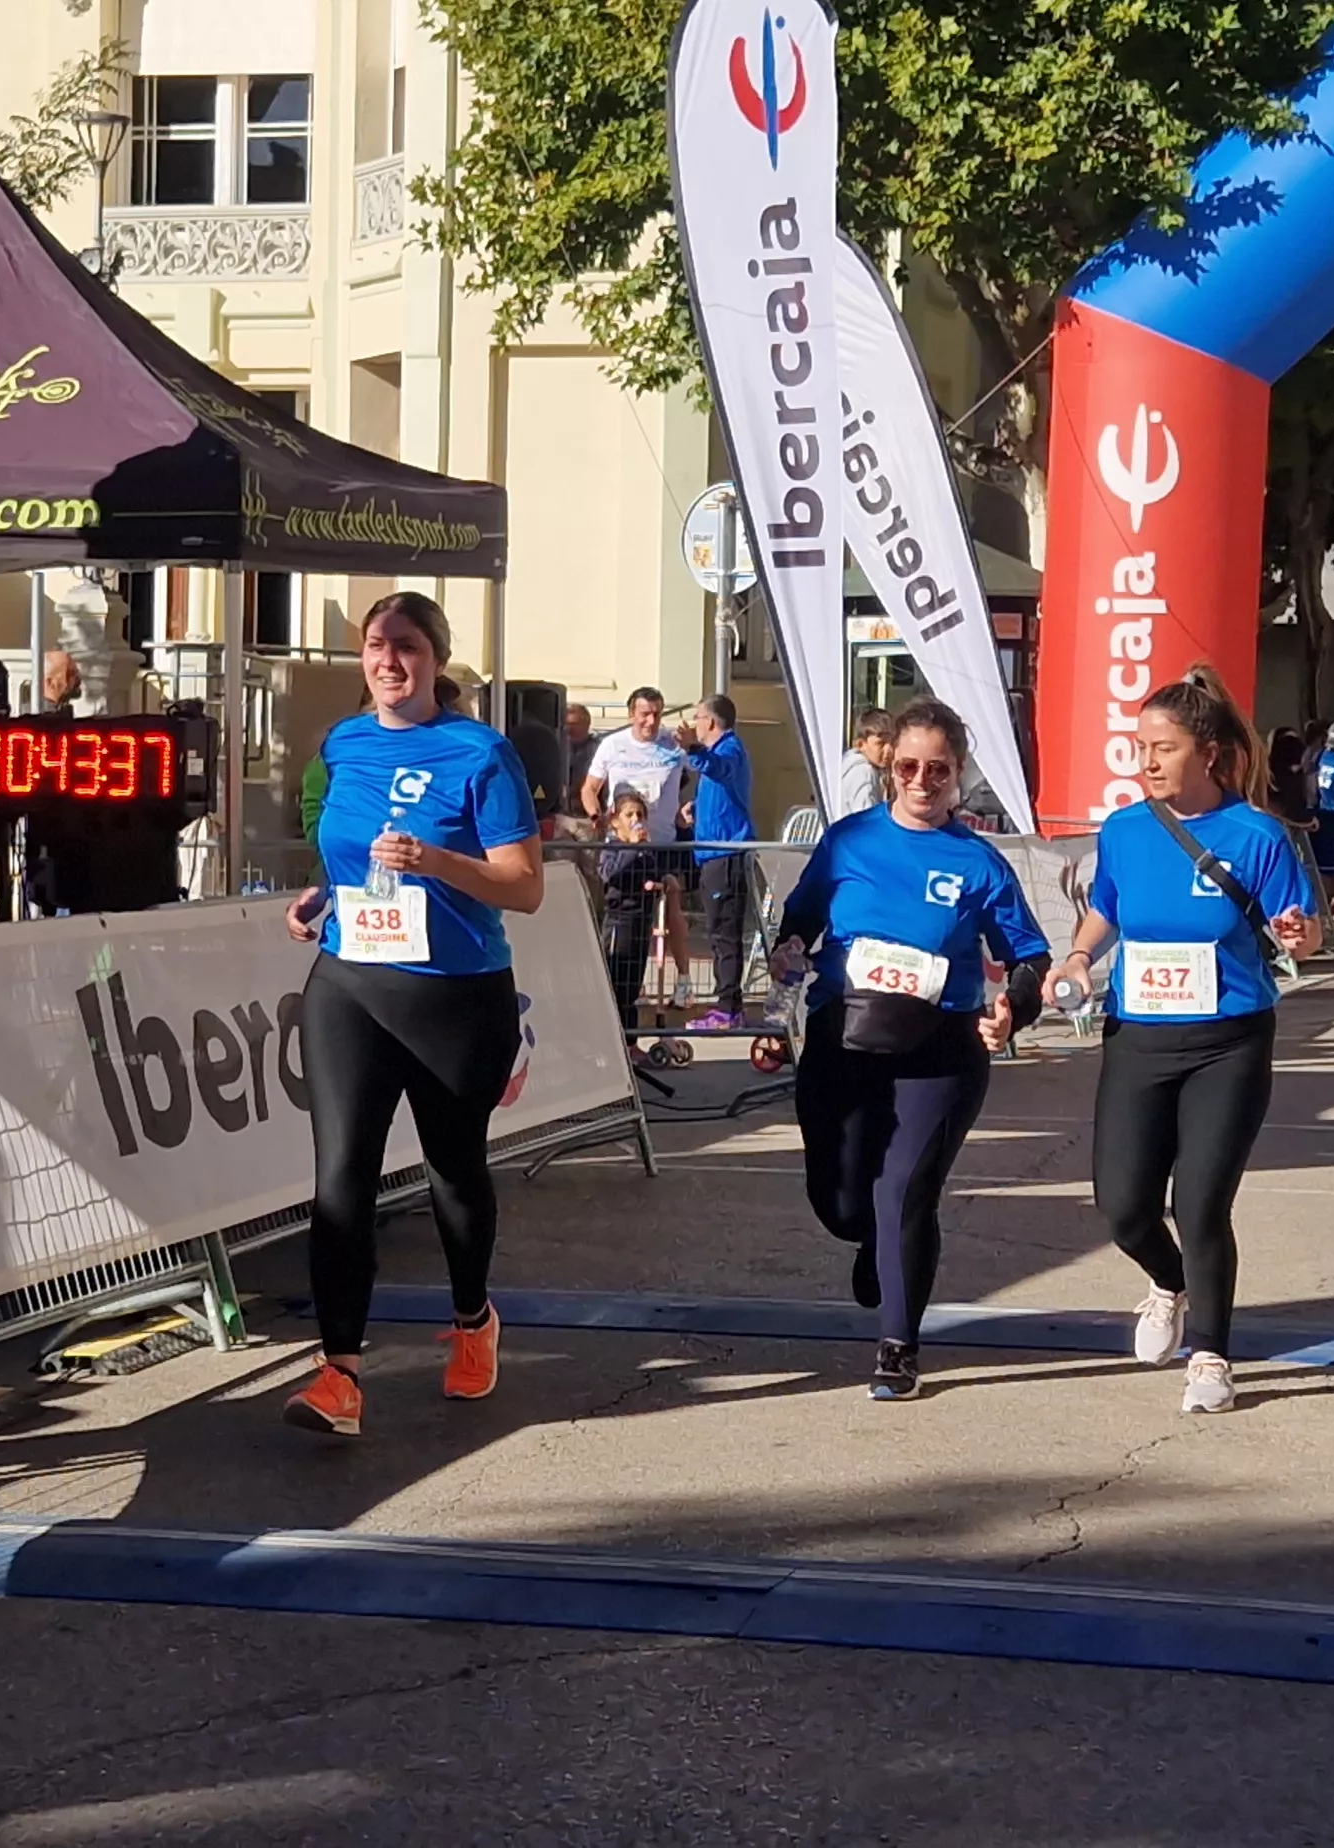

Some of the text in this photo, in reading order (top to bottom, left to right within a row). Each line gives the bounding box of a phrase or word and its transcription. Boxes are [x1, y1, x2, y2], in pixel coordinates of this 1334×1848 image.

[747, 196, 826, 570] Ibercaja
[283, 494, 483, 561] www.fartlecksport.com
[1089, 550, 1169, 821] bercaja
[354, 908, 404, 931] 438
[866, 964, 920, 994] 433
[1140, 966, 1192, 989] 437
[1139, 990, 1196, 1001] ANDREEA
